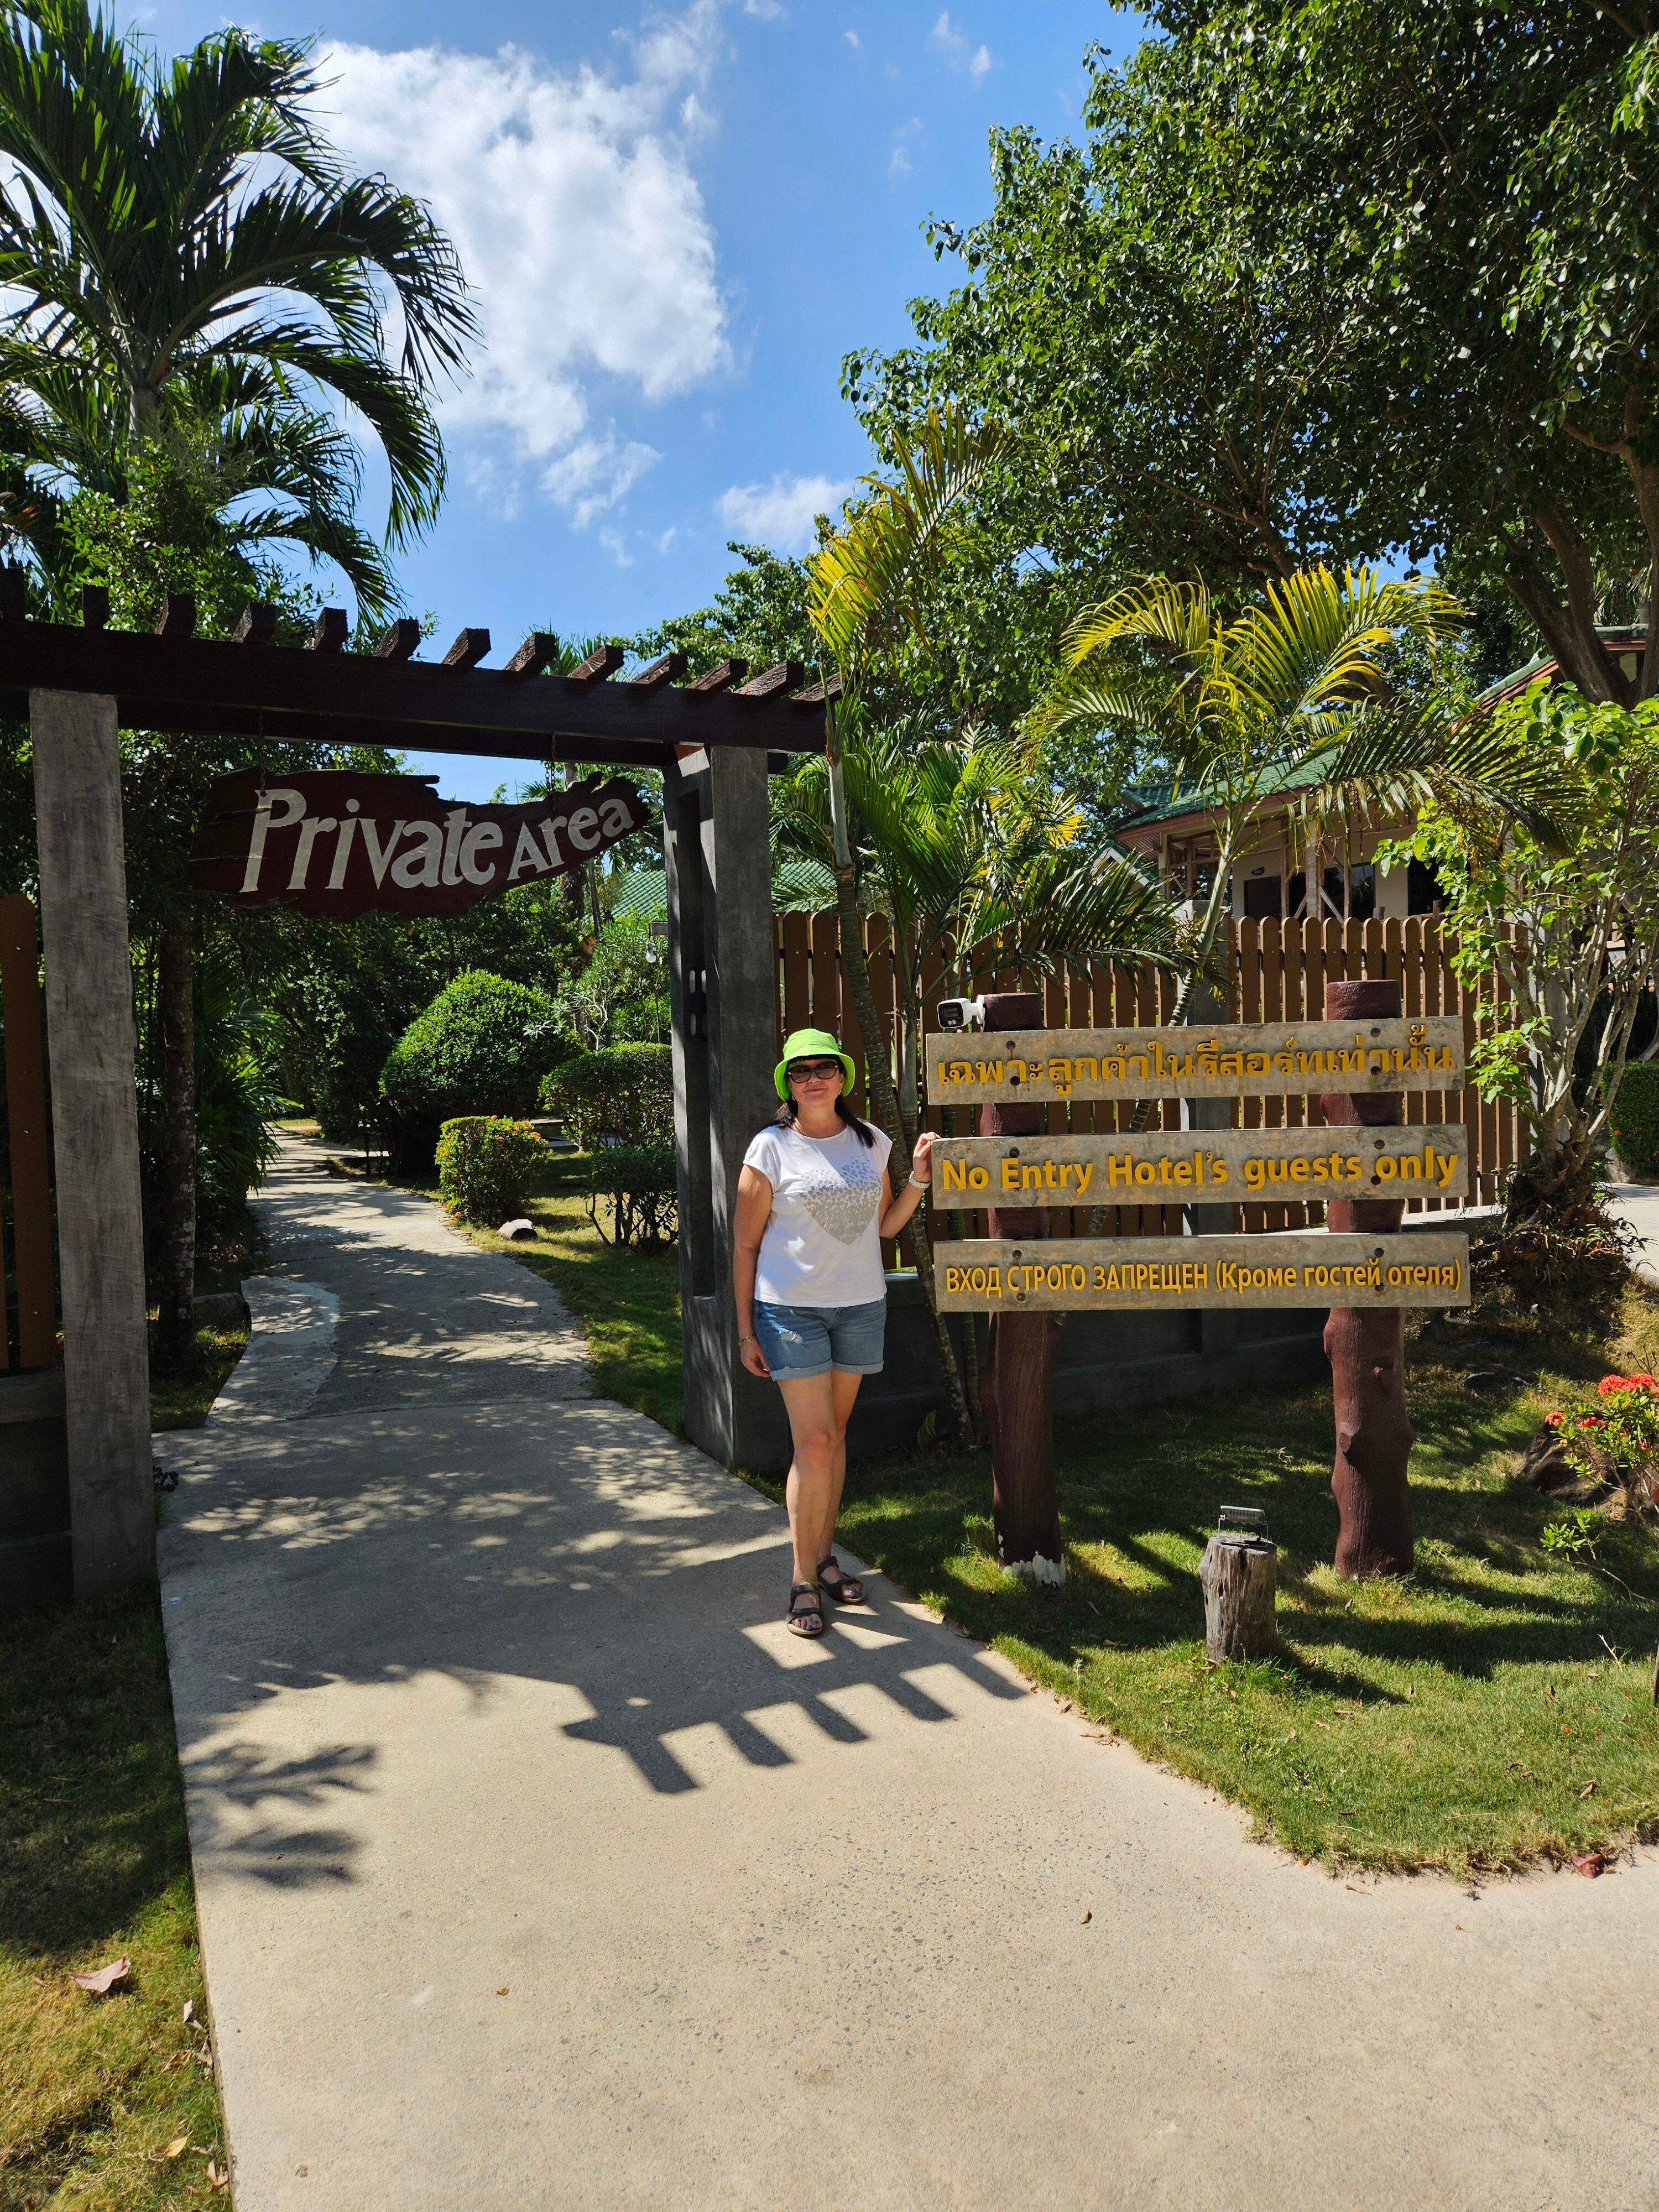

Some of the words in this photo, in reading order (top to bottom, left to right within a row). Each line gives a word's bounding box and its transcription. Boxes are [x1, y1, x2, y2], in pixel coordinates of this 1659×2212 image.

[239, 788, 503, 894] Private
[507, 798, 635, 880] Area
[937, 1024, 1454, 1096] เฉพาะลูกค้าในรีสอร์ทเท่านั้น
[941, 1159, 990, 1191] No
[1000, 1157, 1095, 1195] Entry
[1107, 1151, 1229, 1187] Hotel's
[1243, 1152, 1363, 1191] guests
[1375, 1145, 1459, 1188] only
[945, 1266, 1003, 1298] ВХОД
[1006, 1264, 1087, 1292] СТРОГО
[1092, 1262, 1209, 1295] ЗАПРЕЩЕН
[1215, 1261, 1298, 1293] (Кроме
[1304, 1259, 1381, 1287] гостей
[1387, 1259, 1462, 1290] отеля)
